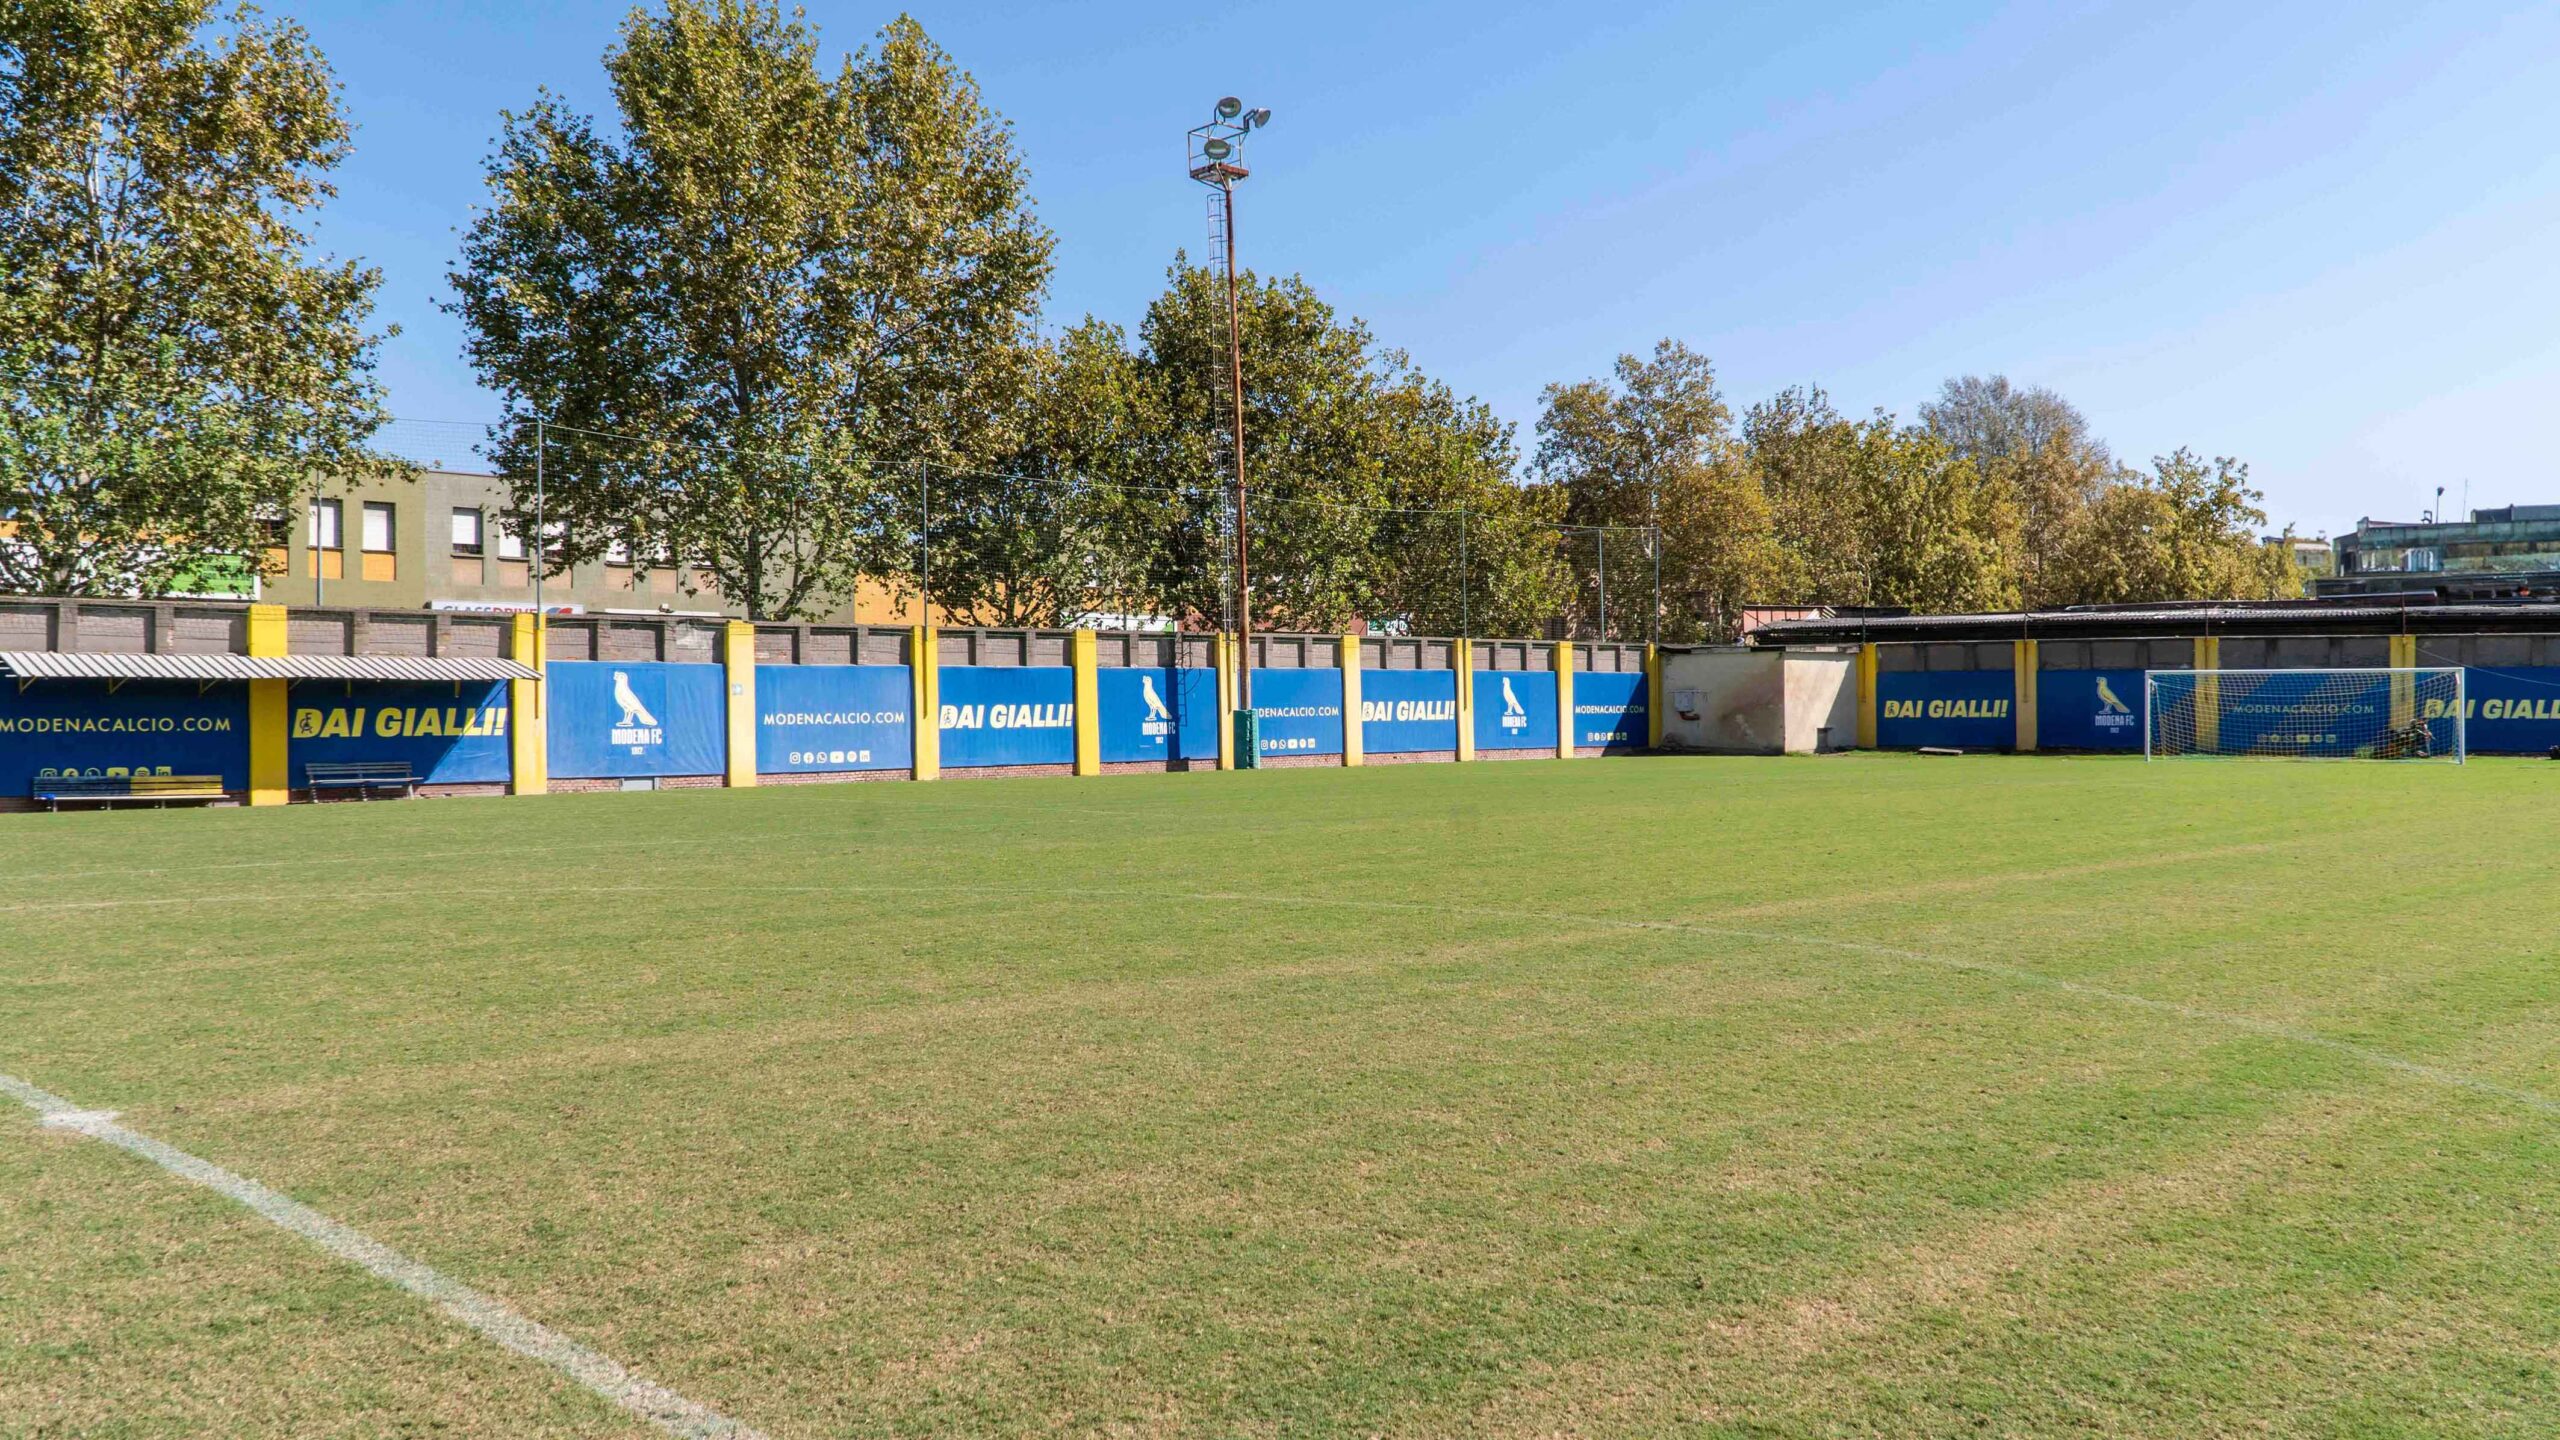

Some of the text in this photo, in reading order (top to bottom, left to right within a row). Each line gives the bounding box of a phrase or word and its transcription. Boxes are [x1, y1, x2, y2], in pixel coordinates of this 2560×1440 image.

[939, 703, 1073, 729] DAI GIALLI!
[1259, 706, 1339, 718] DENACALCIO.COM
[1361, 700, 1456, 722] DAI GIALLI!
[1575, 705, 1645, 714] MODENACALCIO.COM
[1884, 699, 2009, 719] DAI GIALLI!
[0, 717, 231, 732] MODENACALCIO.COM
[292, 707, 508, 738] DAI GIALLI!
[763, 711, 905, 726] MODENACALCIO.COM
[2094, 714, 2135, 726] MODENA FC
[1168, 721, 1176, 735] FC
[611, 728, 662, 745] MODENA FC
